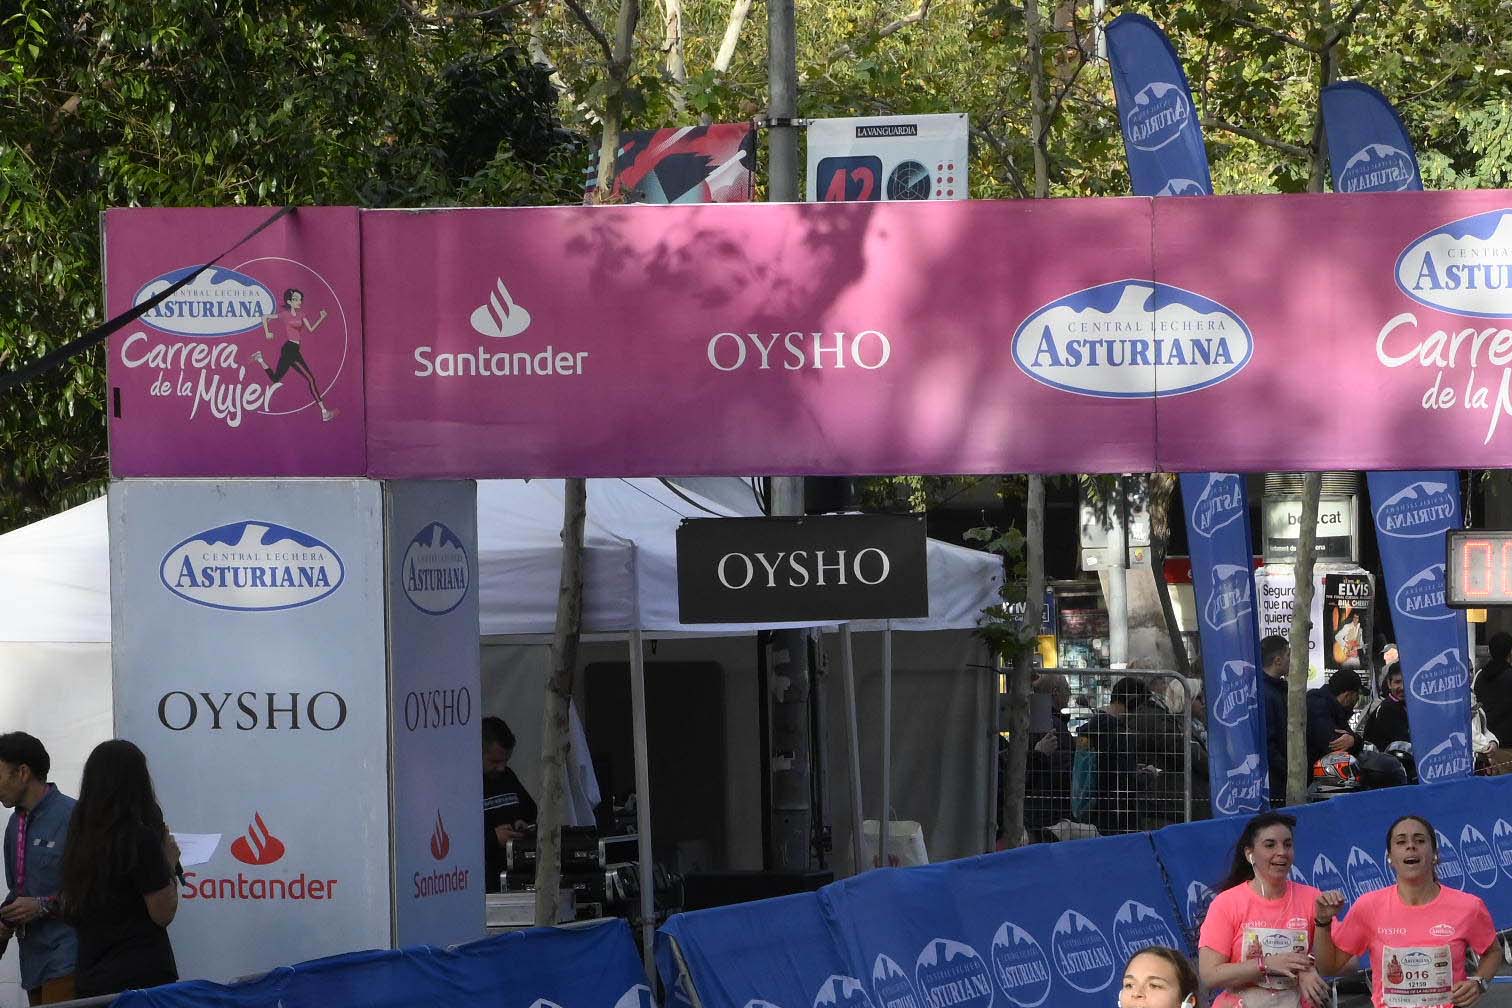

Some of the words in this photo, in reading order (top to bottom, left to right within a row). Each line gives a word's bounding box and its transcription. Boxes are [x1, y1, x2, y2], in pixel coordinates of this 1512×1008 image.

[857, 129, 867, 137] LA
[867, 125, 916, 136] VANGUARDIA
[145, 292, 265, 318] ASTURIANA
[1067, 322, 1142, 333] CENTRAL
[1150, 320, 1227, 331] LECHERA
[121, 331, 239, 370] Carrera
[414, 346, 588, 376] Santander
[707, 330, 891, 371] OYSHO
[1031, 325, 1235, 368] ASTURIANA
[150, 371, 172, 397] de
[177, 371, 193, 397] la
[190, 366, 283, 427] Mujer
[1421, 371, 1456, 410] de
[1464, 371, 1489, 410] la
[174, 554, 331, 588] ASTURIANA
[202, 552, 261, 562] CENTRAL
[266, 552, 325, 561] LECHERA
[718, 547, 890, 589] OYSHO
[408, 559, 466, 592] ASTURIANA
[1338, 583, 1369, 596] ELVIS
[1263, 601, 1279, 609] que
[157, 691, 347, 731] OYSHO
[405, 686, 471, 732] OYSHO
[182, 872, 338, 900] Santander
[414, 866, 469, 899] Santander
[1378, 927, 1407, 935] OYSHO
[1406, 971, 1429, 980] 016
